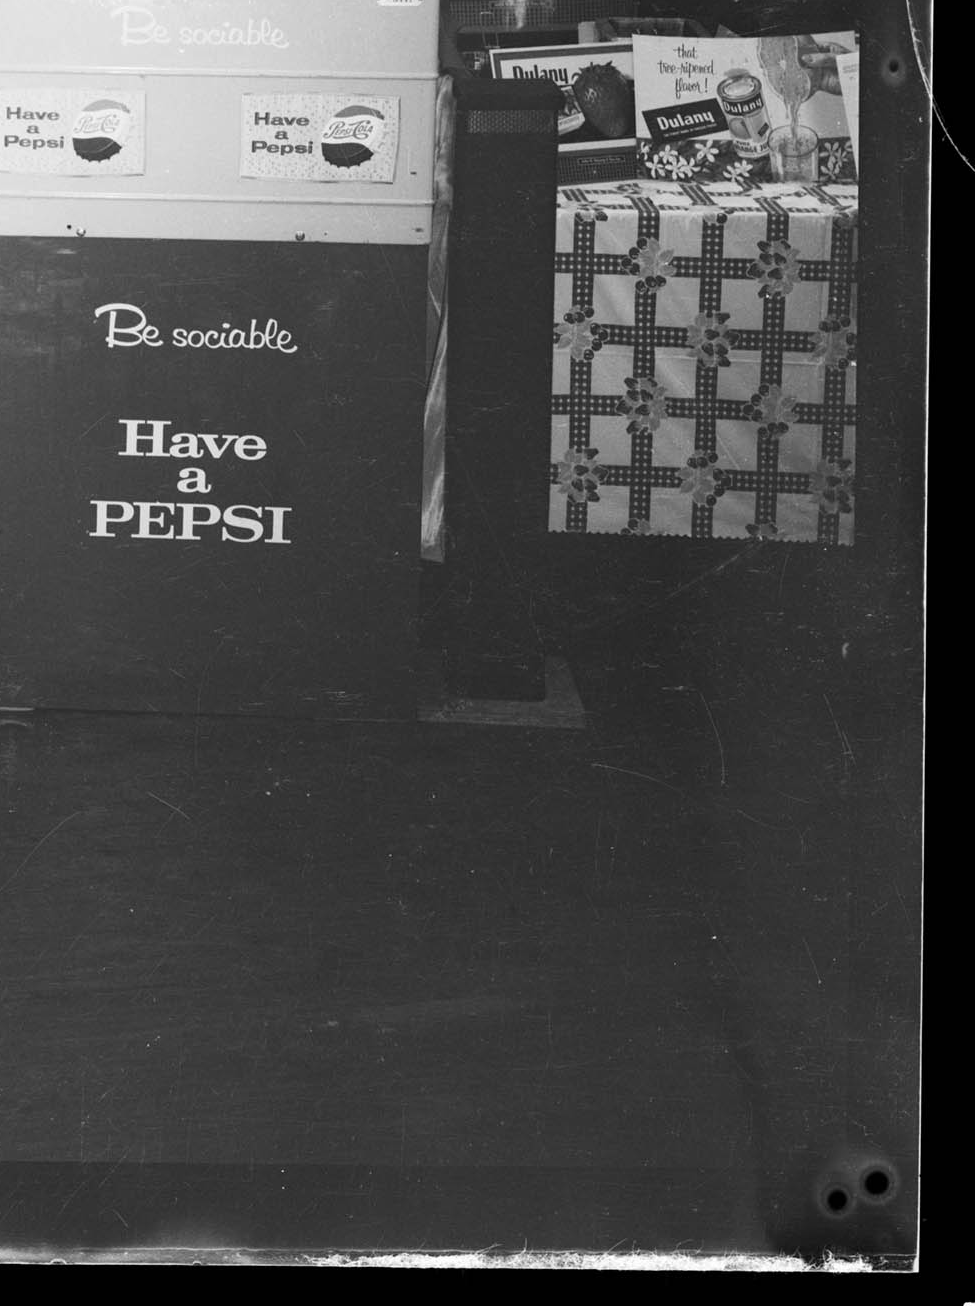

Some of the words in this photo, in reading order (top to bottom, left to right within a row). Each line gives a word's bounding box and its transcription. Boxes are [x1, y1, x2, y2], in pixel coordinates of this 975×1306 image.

[110, 6, 170, 45] Be
[180, 18, 289, 48] sociable
[673, 43, 697, 59] that
[657, 59, 714, 78] tree-ripened
[6, 107, 59, 120] Have
[724, 98, 762, 113] Dulany
[254, 112, 309, 126] Have
[657, 112, 715, 130] Dulany
[26, 125, 39, 134] a
[275, 131, 288, 140] a
[4, 135, 64, 150] Pepsi
[251, 141, 313, 155] Pepsi
[94, 302, 163, 348] Be
[172, 318, 298, 353] sociable
[118, 419, 267, 460] Have
[177, 467, 211, 493] a
[89, 500, 292, 544] PEPSI
